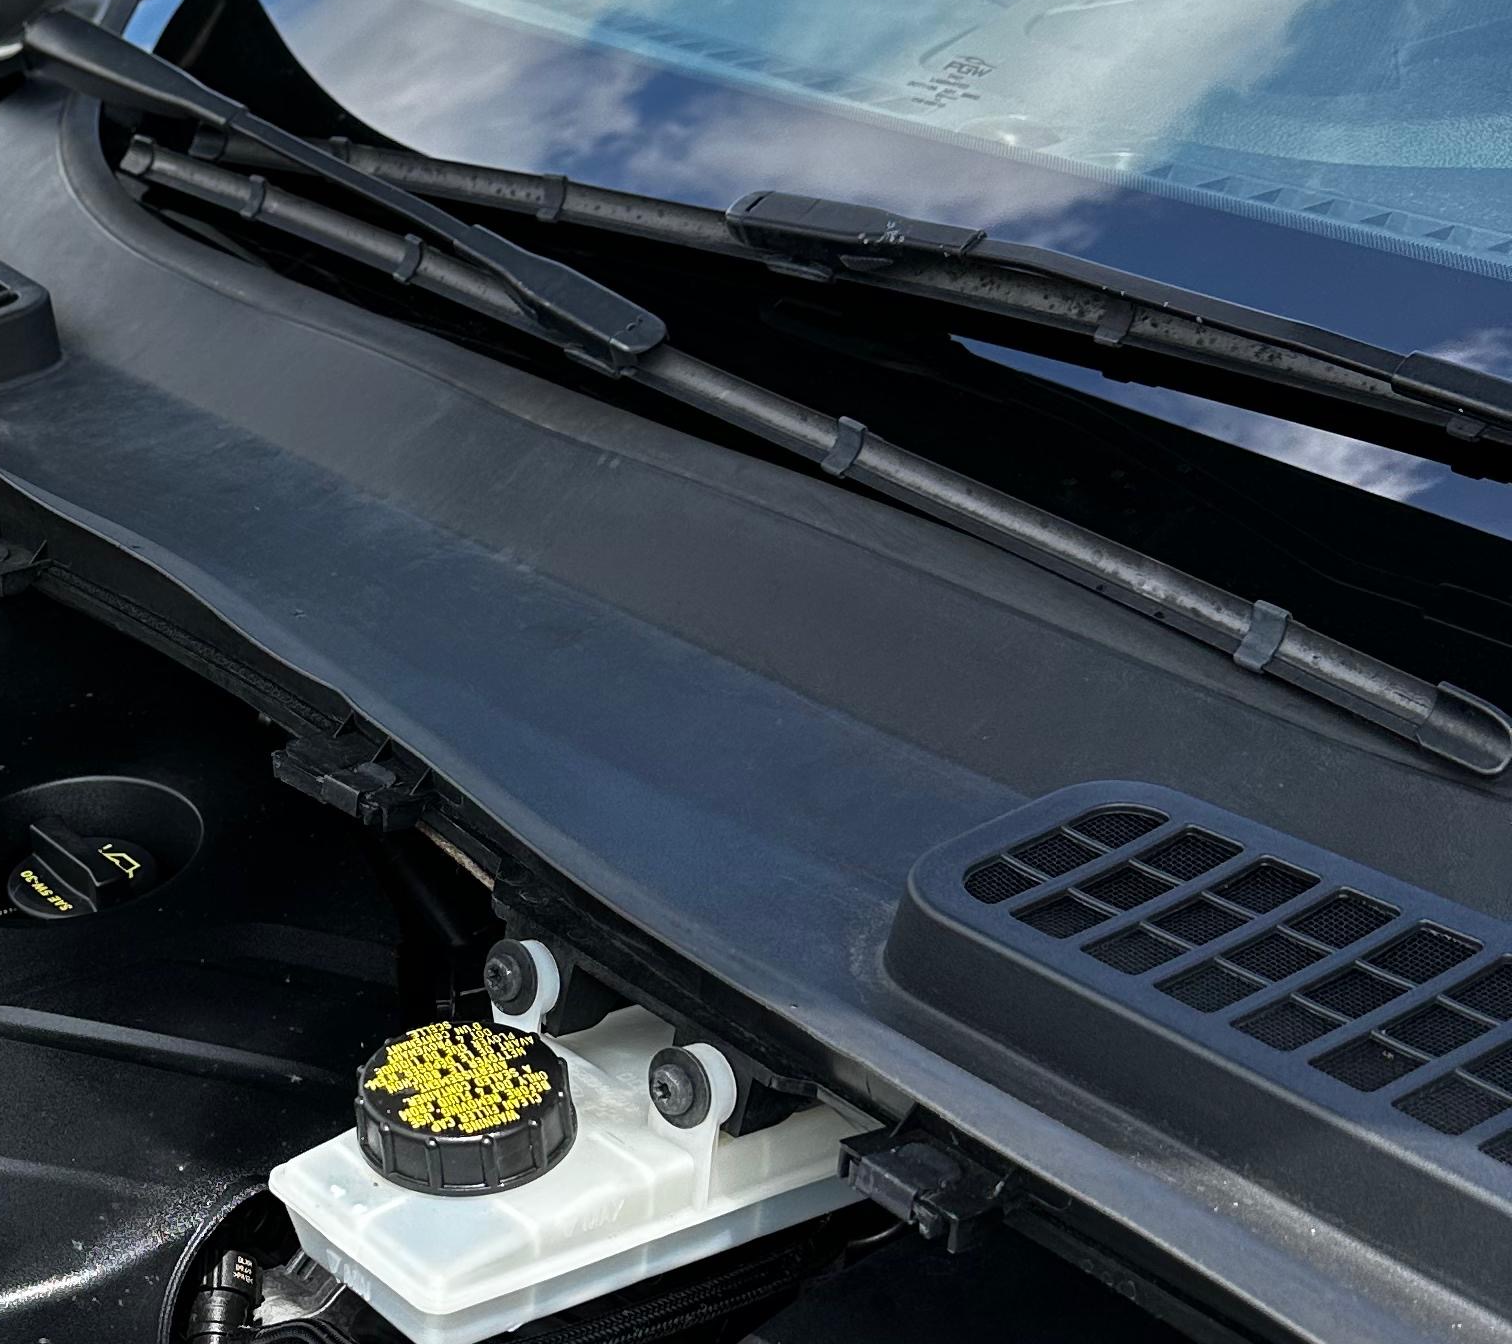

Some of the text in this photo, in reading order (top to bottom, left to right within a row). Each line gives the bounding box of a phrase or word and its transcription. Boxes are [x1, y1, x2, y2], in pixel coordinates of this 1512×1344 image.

[19, 869, 73, 912] SAE 5W-30
[387, 1023, 481, 1055] D'UN CONTENANT
[471, 1029, 492, 1040] DOT
[472, 1032, 515, 1049] PLOYER
[388, 1040, 452, 1064] PROVENANT
[445, 1044, 467, 1056] QUE
[500, 1036, 534, 1052] AVANT
[468, 1046, 526, 1070] NETTOYER
[375, 1058, 420, 1077] LIQUIDE
[386, 1071, 442, 1093] BOUCHON
[475, 1069, 519, 1087] SEALED
[491, 1080, 513, 1093] DOT
[518, 1071, 548, 1086] ONLY
[506, 1080, 551, 1100] BEFORE
[437, 1091, 473, 1108] FLUID
[399, 1103, 435, 1121] FROM
[409, 1113, 435, 1129] USE
[430, 1093, 542, 1133] CLEAN FILLER CAP
